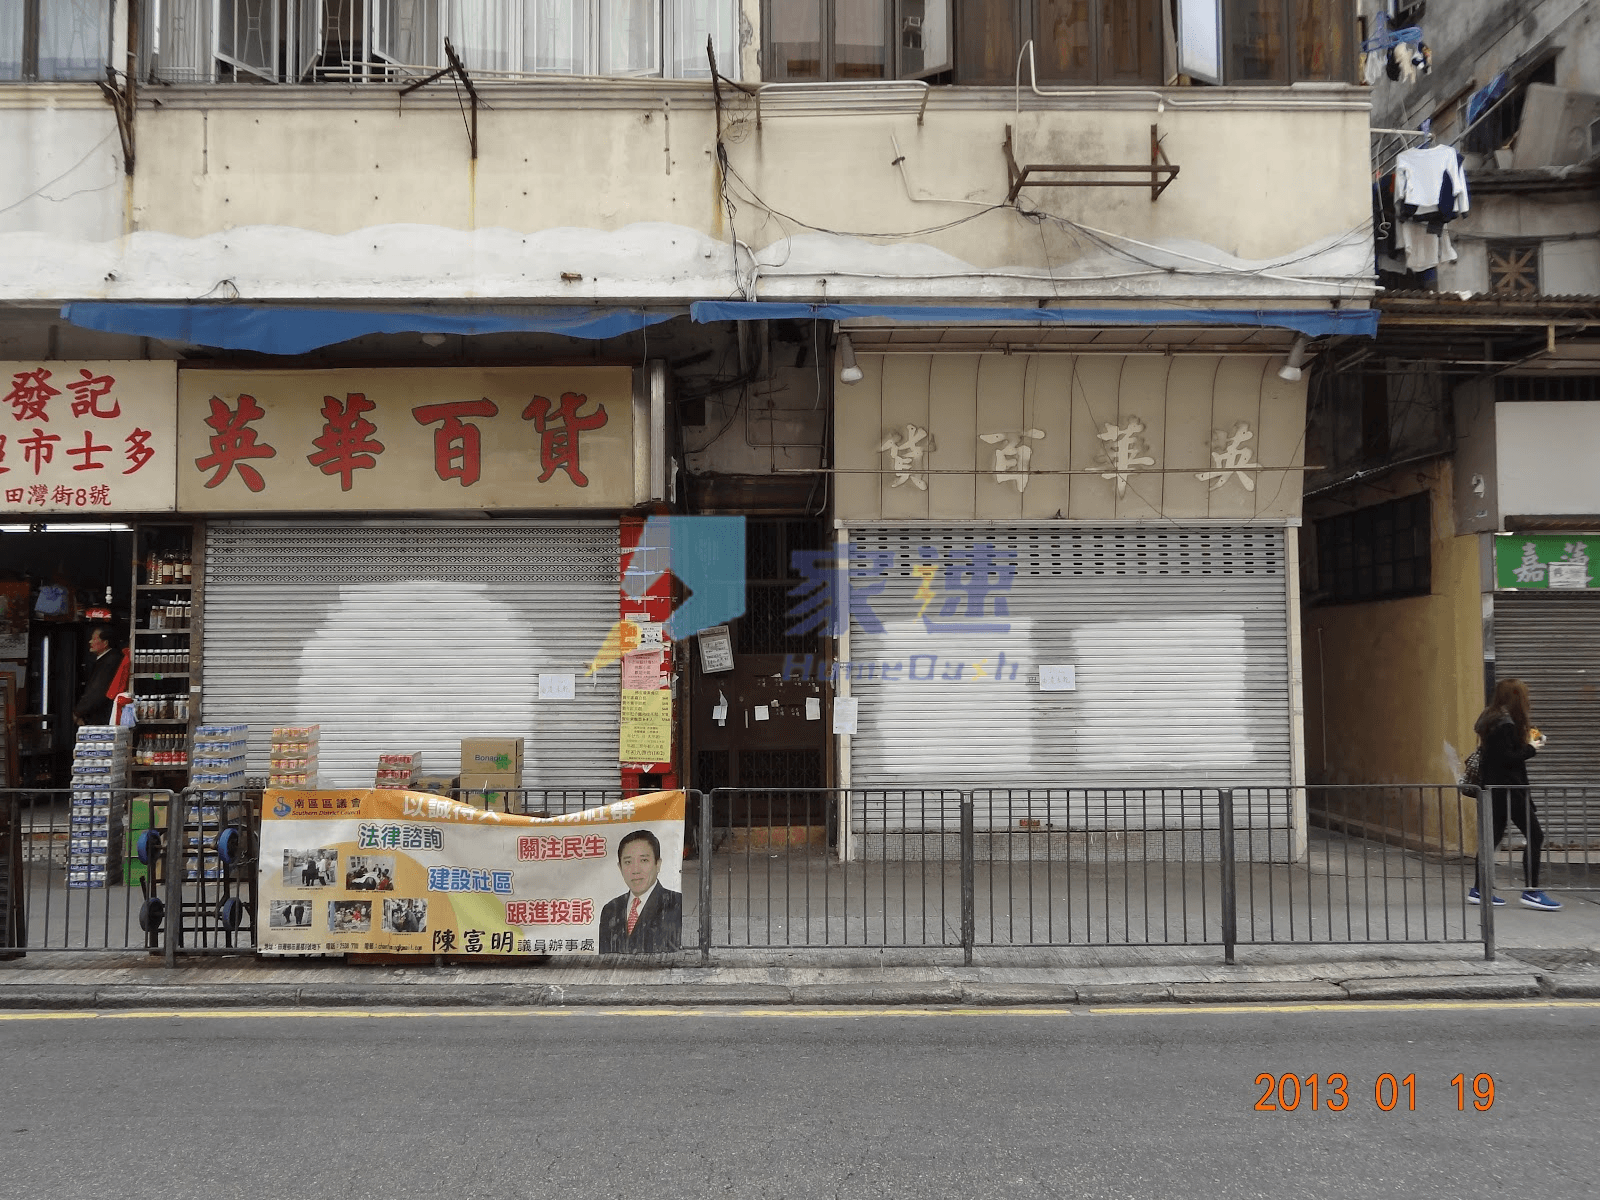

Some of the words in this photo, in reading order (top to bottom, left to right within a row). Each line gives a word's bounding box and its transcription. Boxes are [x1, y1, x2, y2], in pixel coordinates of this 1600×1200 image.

[3, 367, 121, 422] 發記
[0, 427, 155, 475] 市士多
[195, 392, 608, 492] 英華百貨
[5, 484, 112, 507] 田灣街8號
[294, 797, 361, 809] 南區區議會
[361, 825, 442, 849] 法律諮詢
[518, 835, 606, 861] 關注民生
[429, 866, 513, 893] 建設社區
[506, 899, 594, 925] 跟進投訴
[433, 930, 514, 952] 陳富明
[517, 938, 595, 952] 議員辦事處
